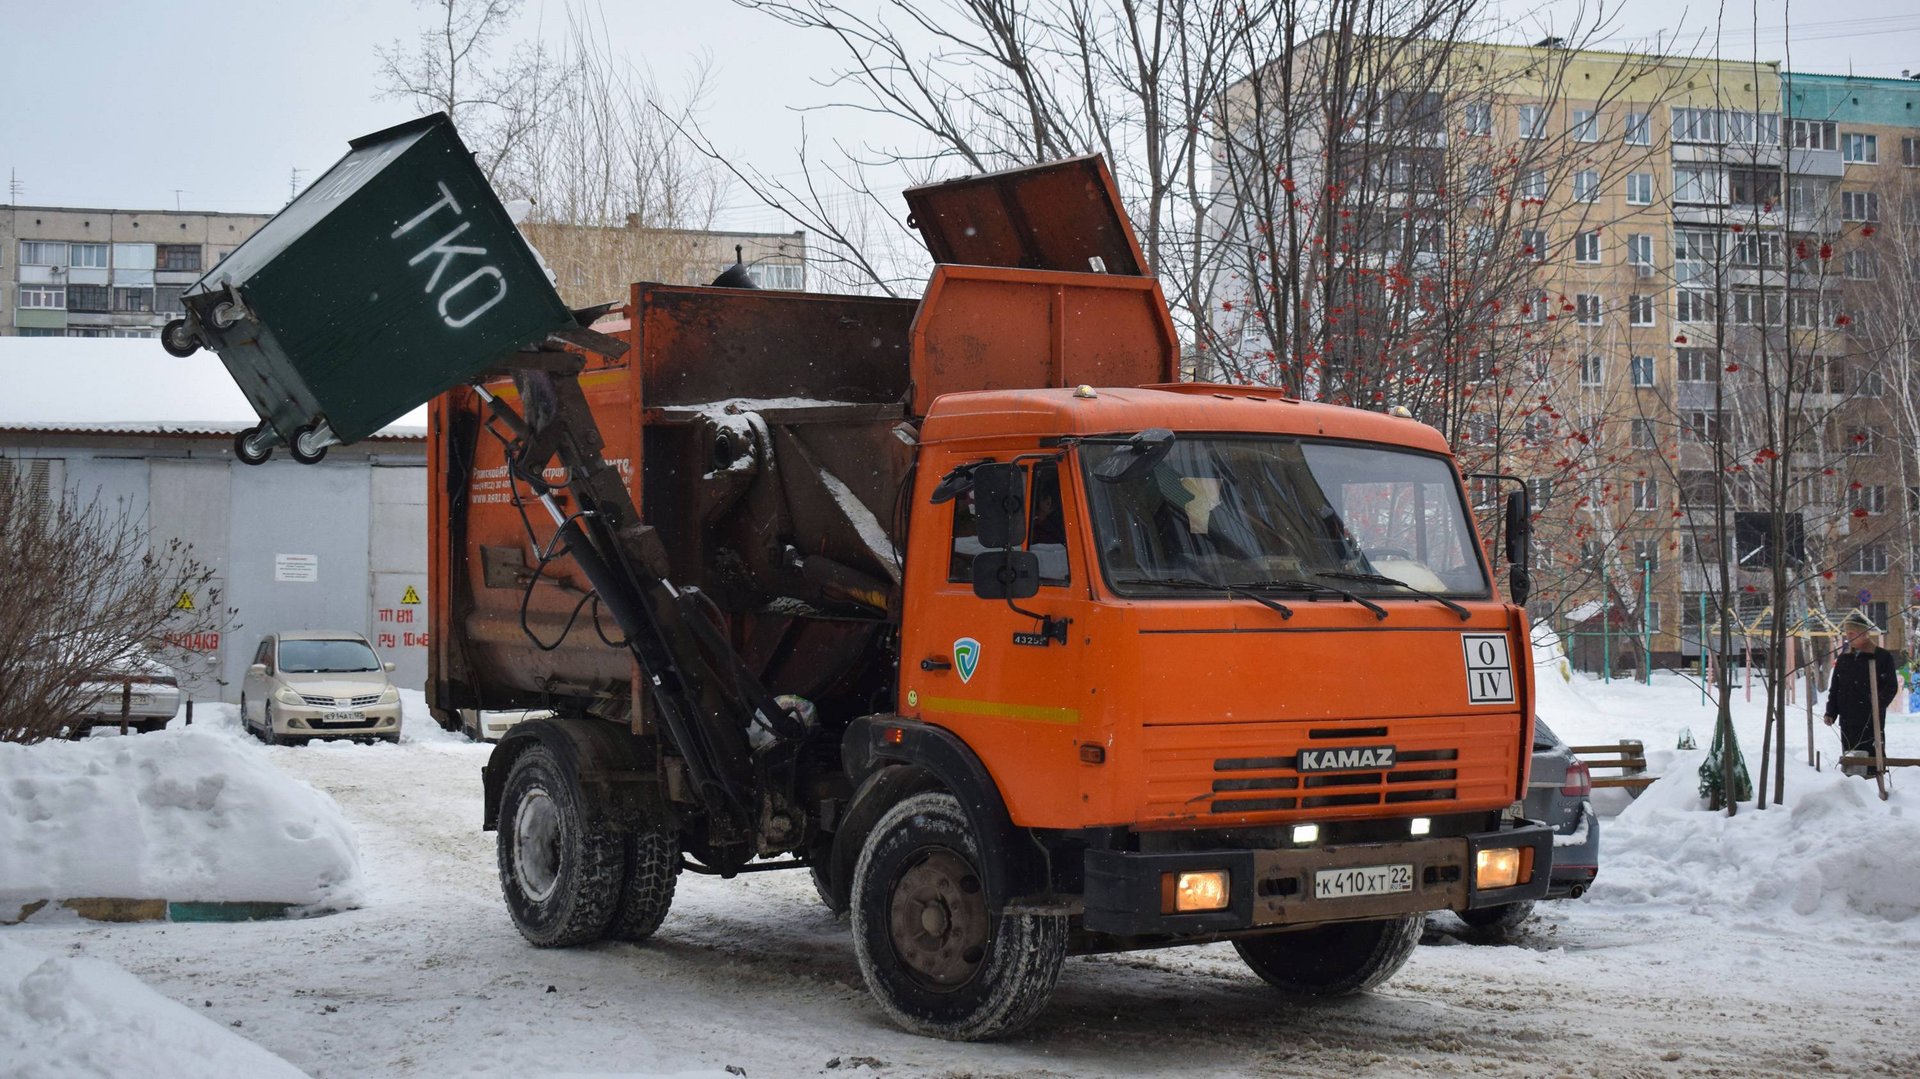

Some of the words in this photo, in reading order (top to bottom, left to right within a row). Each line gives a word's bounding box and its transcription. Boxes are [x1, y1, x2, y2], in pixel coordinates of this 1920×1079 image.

[391, 180, 508, 328] ТКО
[1478, 671, 1502, 697] IV
[1302, 748, 1393, 770] KAMAZ
[1391, 867, 1408, 884] 22
